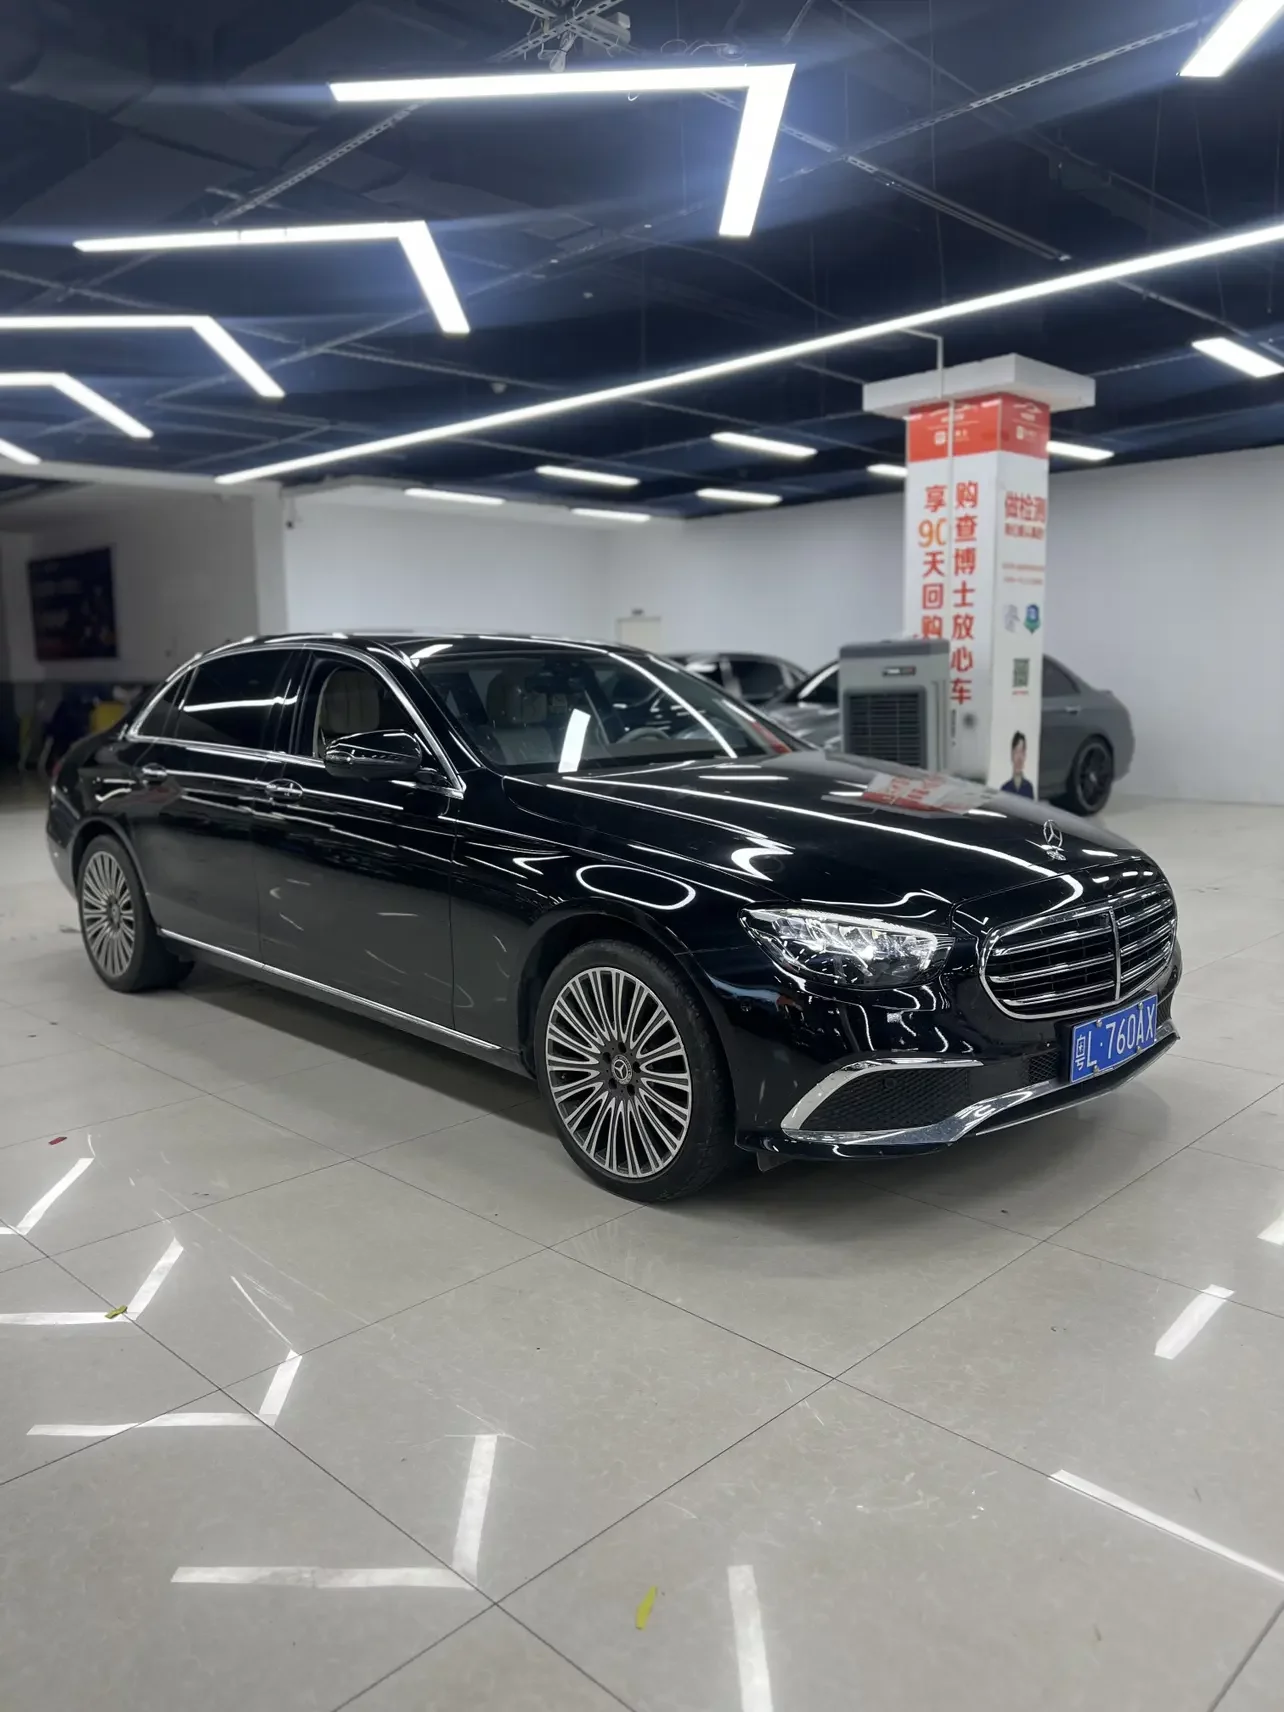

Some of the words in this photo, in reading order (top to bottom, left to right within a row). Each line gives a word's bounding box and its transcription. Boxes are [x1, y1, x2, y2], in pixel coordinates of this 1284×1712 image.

[950, 480, 979, 706] 购查博士放心车
